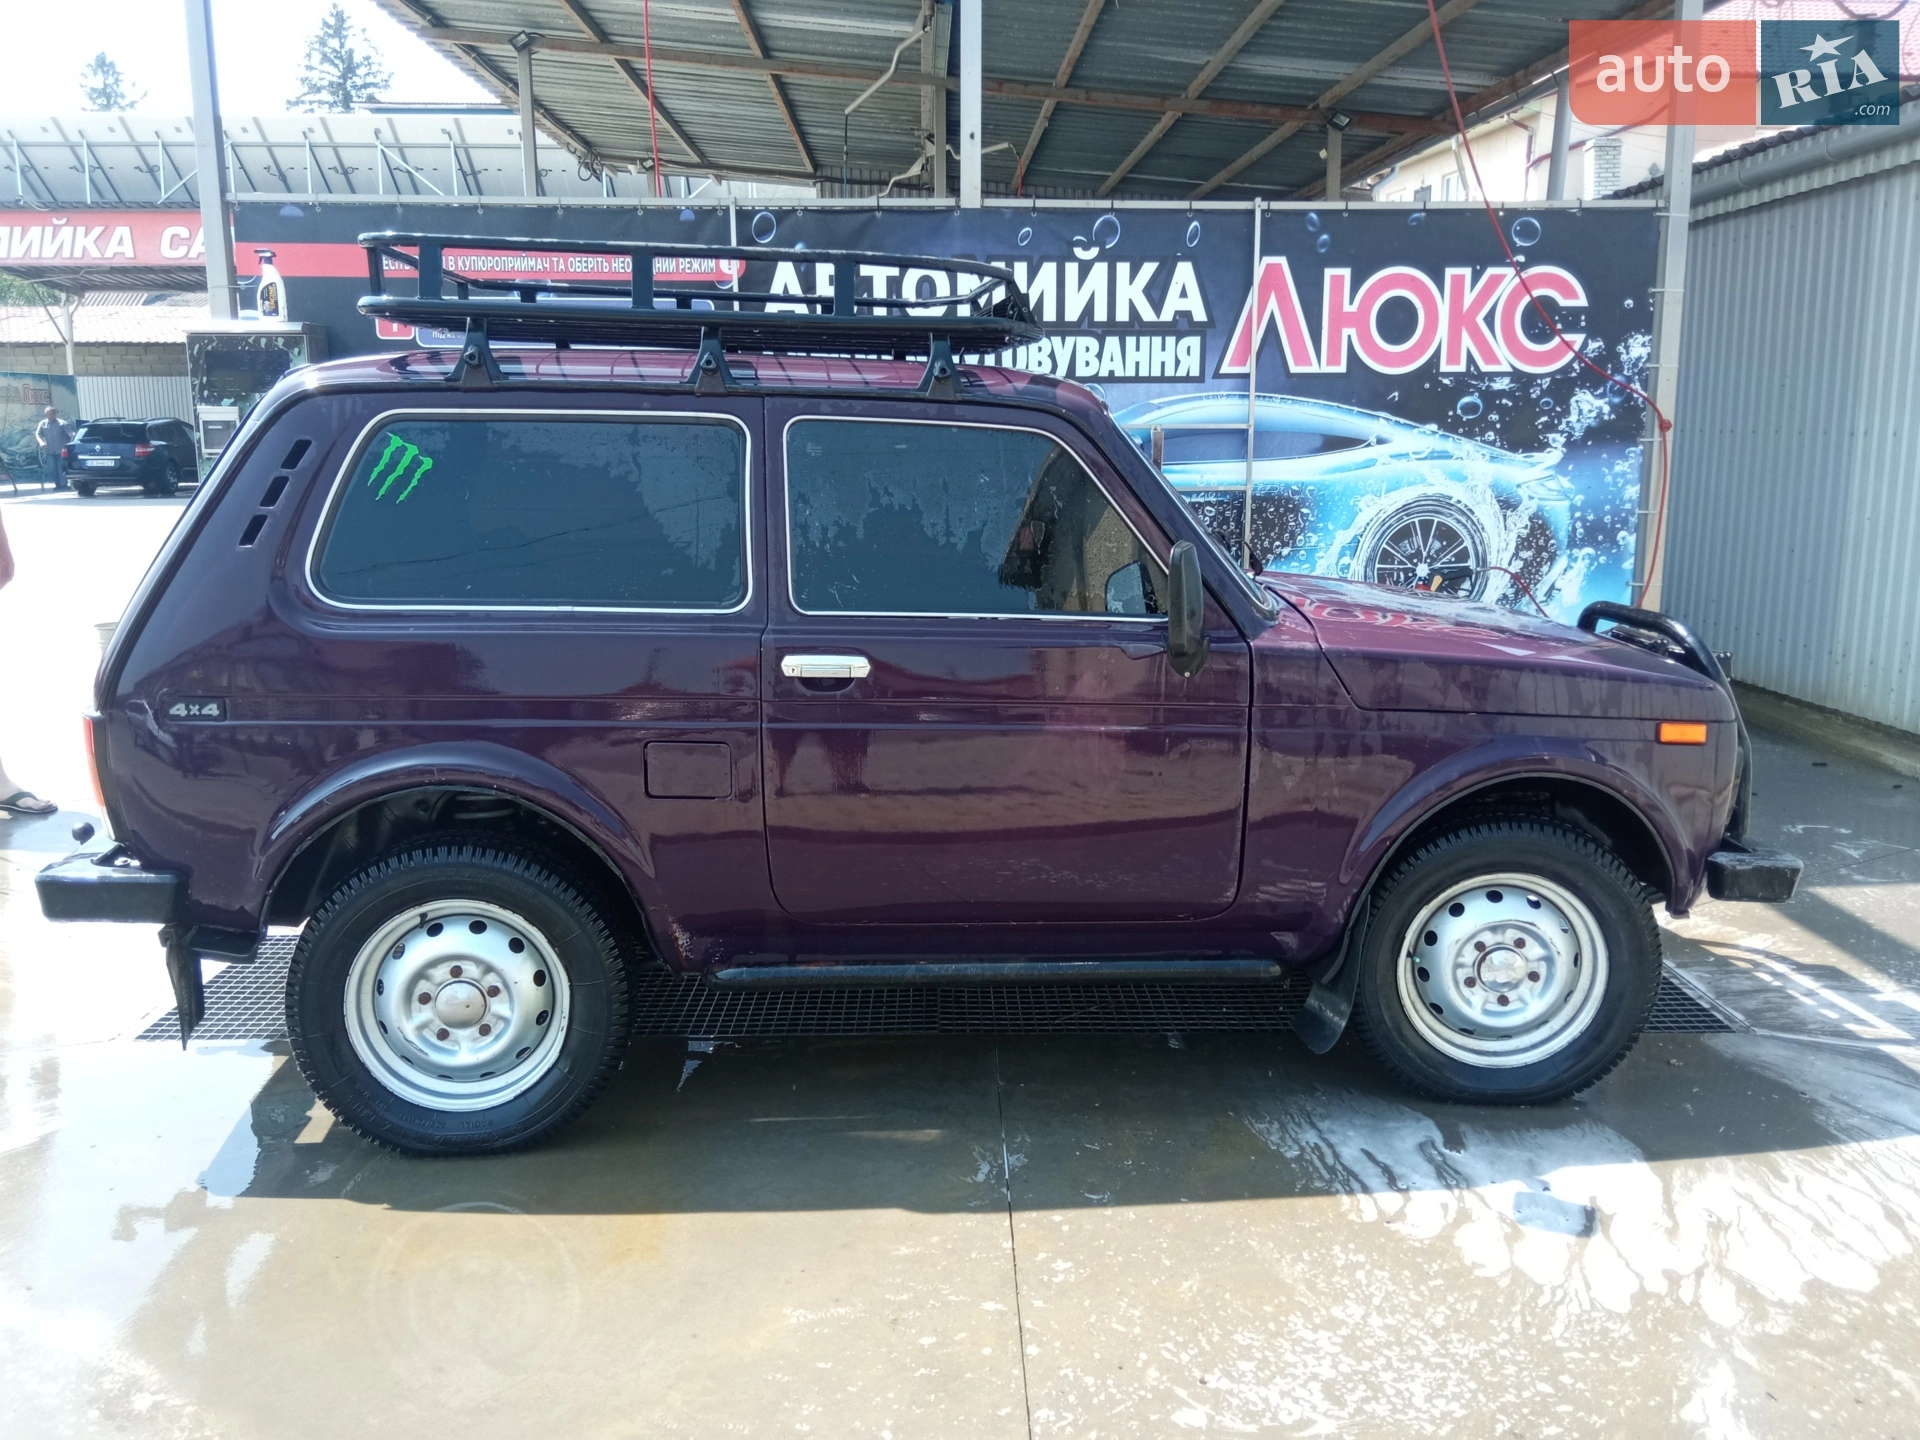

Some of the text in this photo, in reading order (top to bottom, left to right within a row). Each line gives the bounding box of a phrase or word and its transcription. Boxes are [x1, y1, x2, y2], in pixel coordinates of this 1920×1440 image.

[0, 217, 135, 259] ИЙКА
[458, 253, 549, 273] КУПЮРОПРИЙМАЧ
[552, 257, 566, 272] ТА
[568, 257, 609, 273] ОБЕРІТЬ
[679, 258, 716, 273] РЕЖИМ
[1219, 255, 1589, 374] ЛЮКС
[169, 703, 220, 717] 4x4
